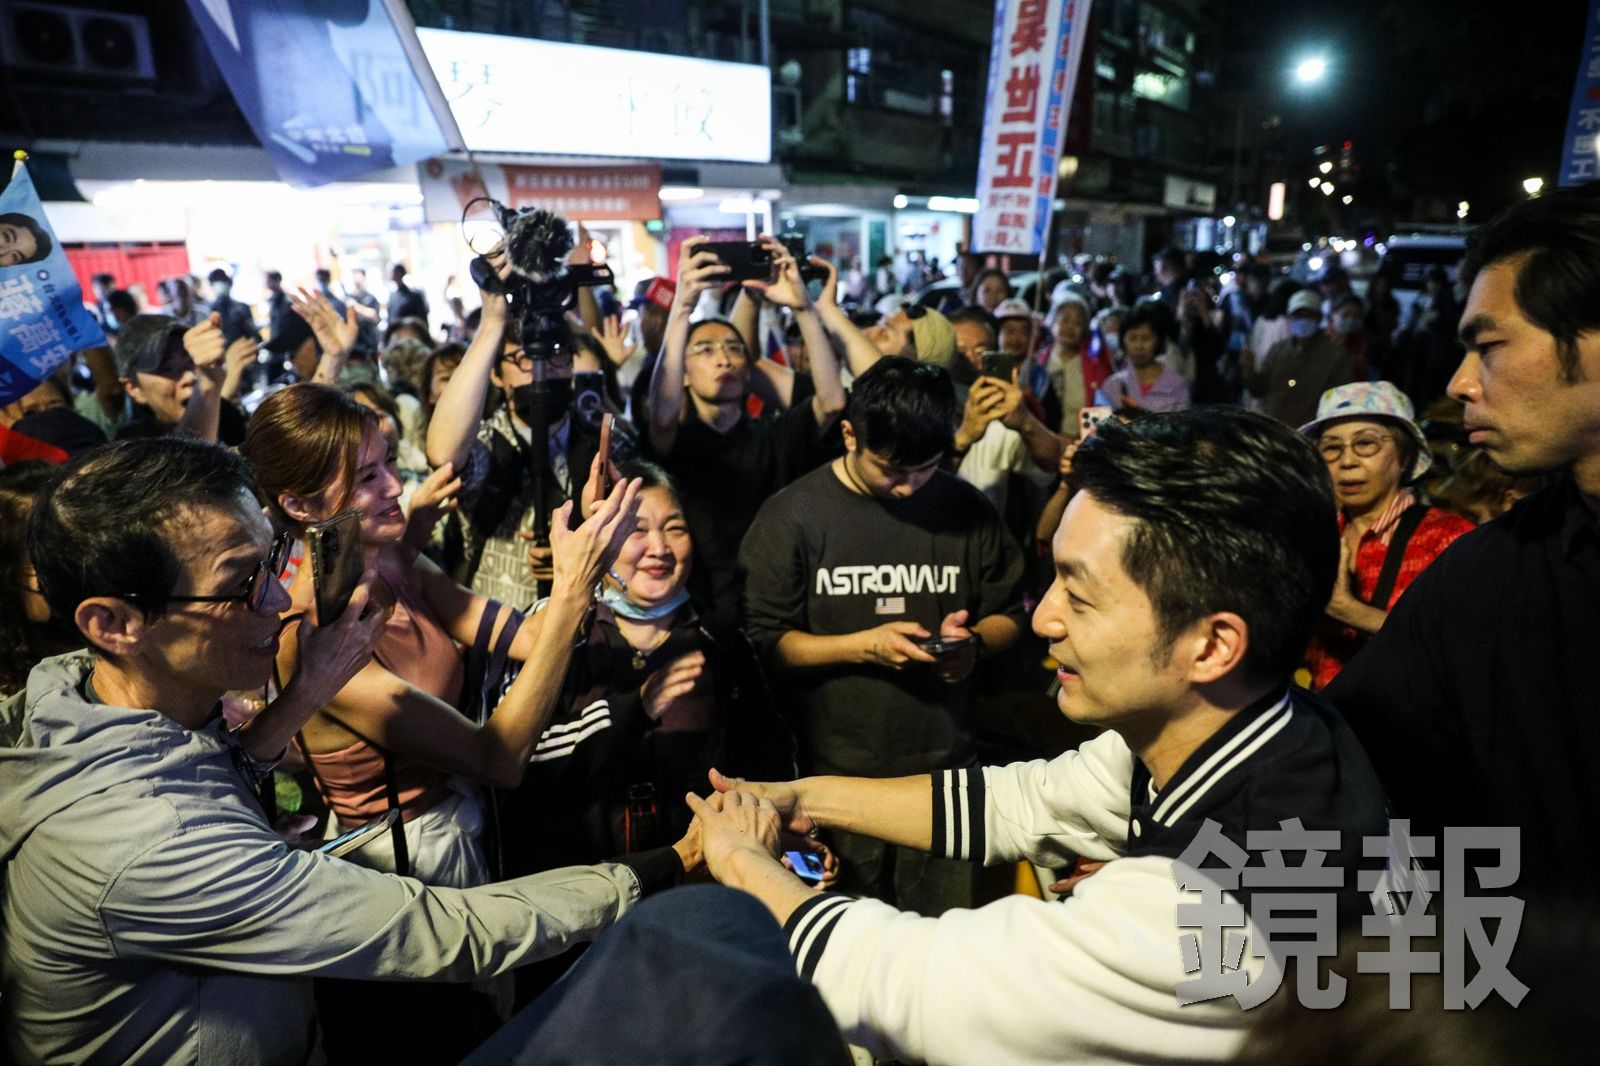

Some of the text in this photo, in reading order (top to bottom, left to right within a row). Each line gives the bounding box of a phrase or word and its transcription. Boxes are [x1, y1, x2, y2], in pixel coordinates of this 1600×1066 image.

[992, 0, 1048, 188] 吳世正
[816, 564, 960, 595] ASTRONAUT
